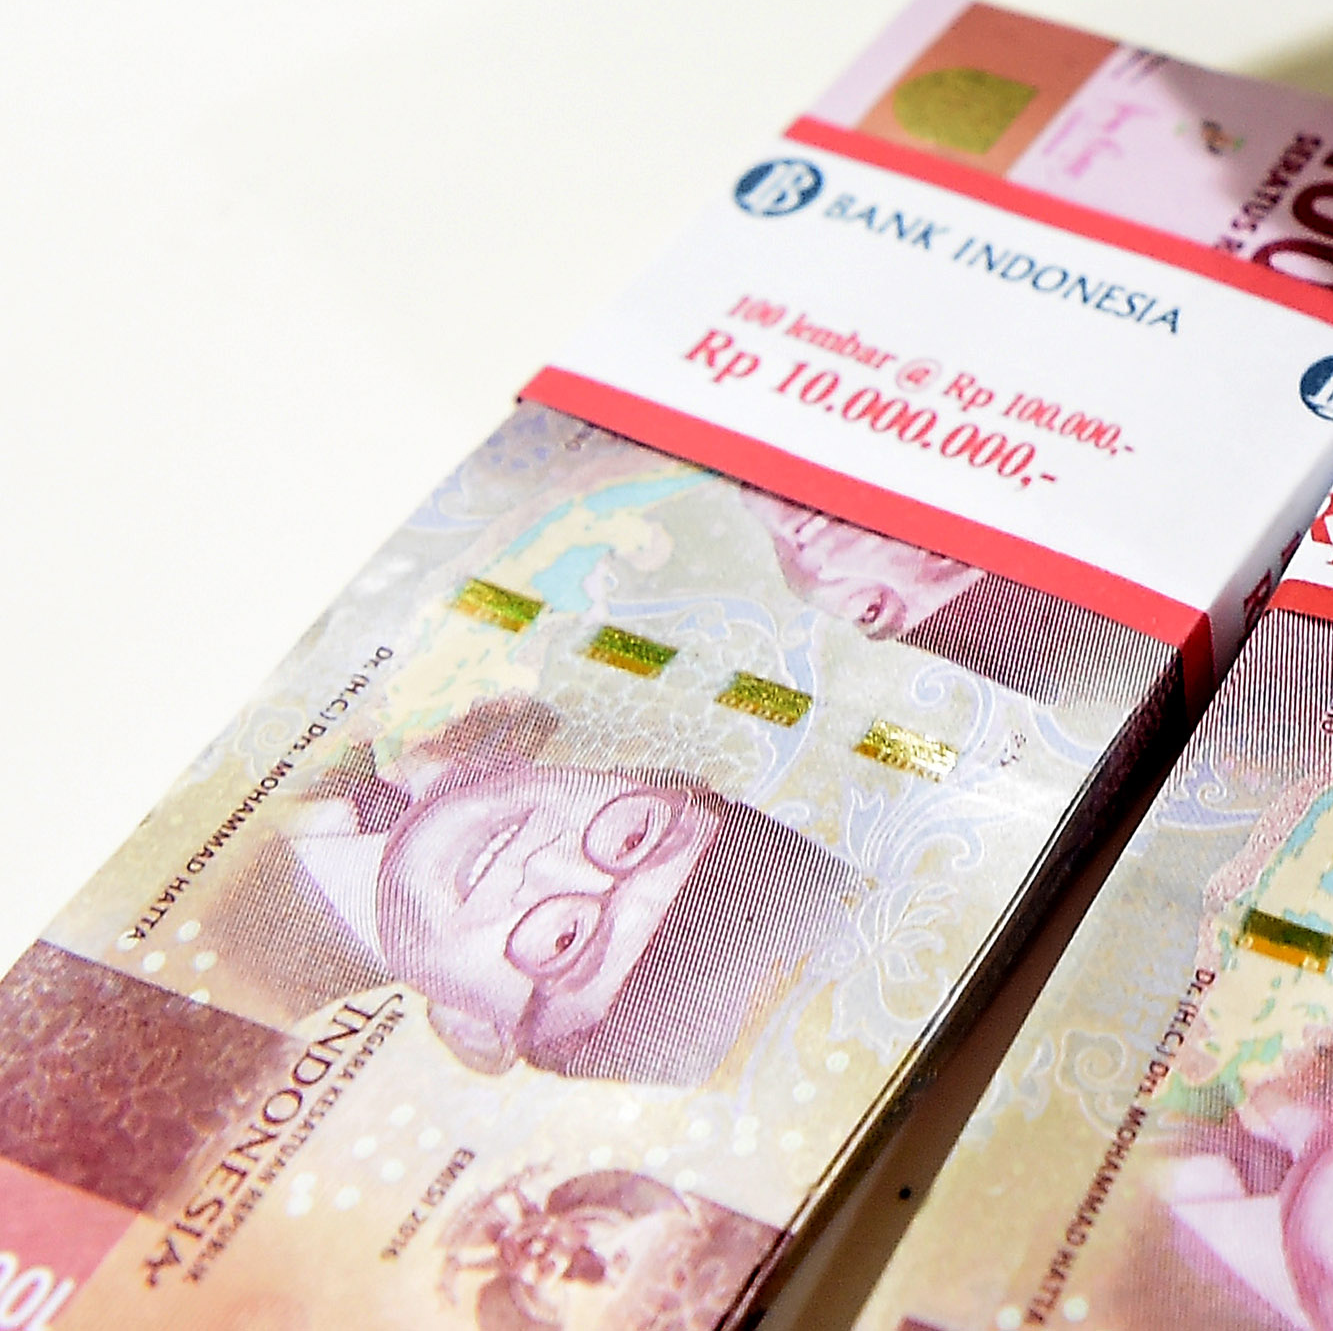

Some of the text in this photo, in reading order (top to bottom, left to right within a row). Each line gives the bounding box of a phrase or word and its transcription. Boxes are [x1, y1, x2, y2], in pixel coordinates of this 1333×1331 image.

[824, 195, 1180, 334] BANK INDONESIA
[683, 328, 1056, 488] Rp 10.000.000,-
[727, 295, 1133, 456] 100 lembar @ Rp 100.000,-
[362, 645, 394, 668] Dr.
[286, 722, 327, 755] Drs.
[184, 760, 293, 875] MOHAMMAD
[128, 876, 189, 940] HATTA
[335, 1009, 404, 1081] NEGARA
[144, 1001, 379, 1287] INDONESIA
[254, 1085, 343, 1190] KESATUAN
[420, 1147, 476, 1208] EMISI
[1023, 968, 1216, 1326] Dr. (H.C.) Drs. MOHAMMAD HATTA
